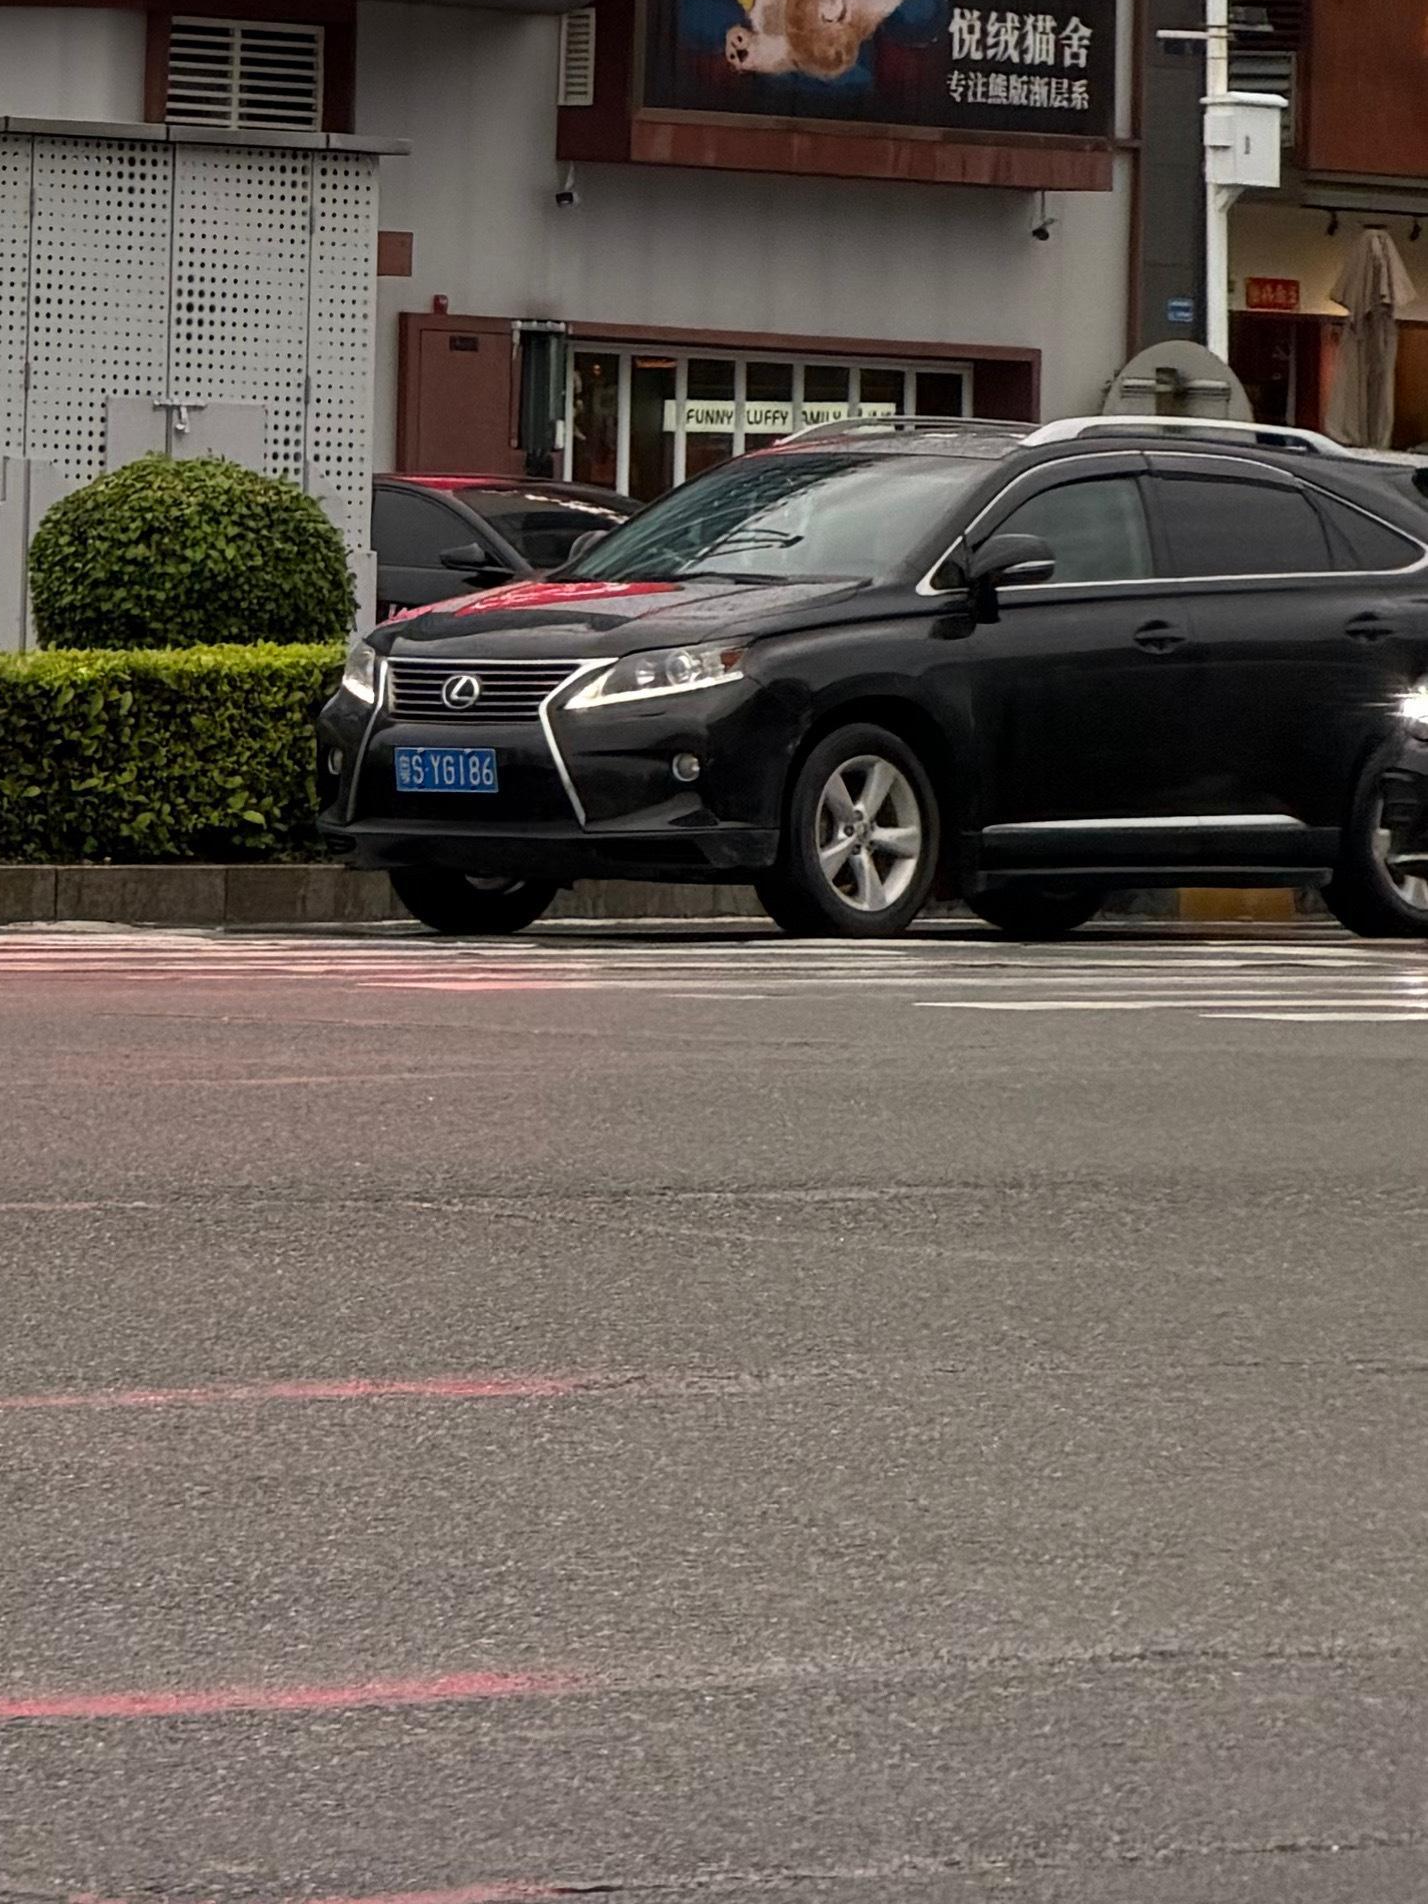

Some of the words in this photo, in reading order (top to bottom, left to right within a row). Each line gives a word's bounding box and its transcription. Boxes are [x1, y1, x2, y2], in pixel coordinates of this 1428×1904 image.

[948, 7, 1093, 69] 悦绒猫舍
[686, 408, 733, 425] FUNNY
[746, 410, 789, 426] LUFFY
